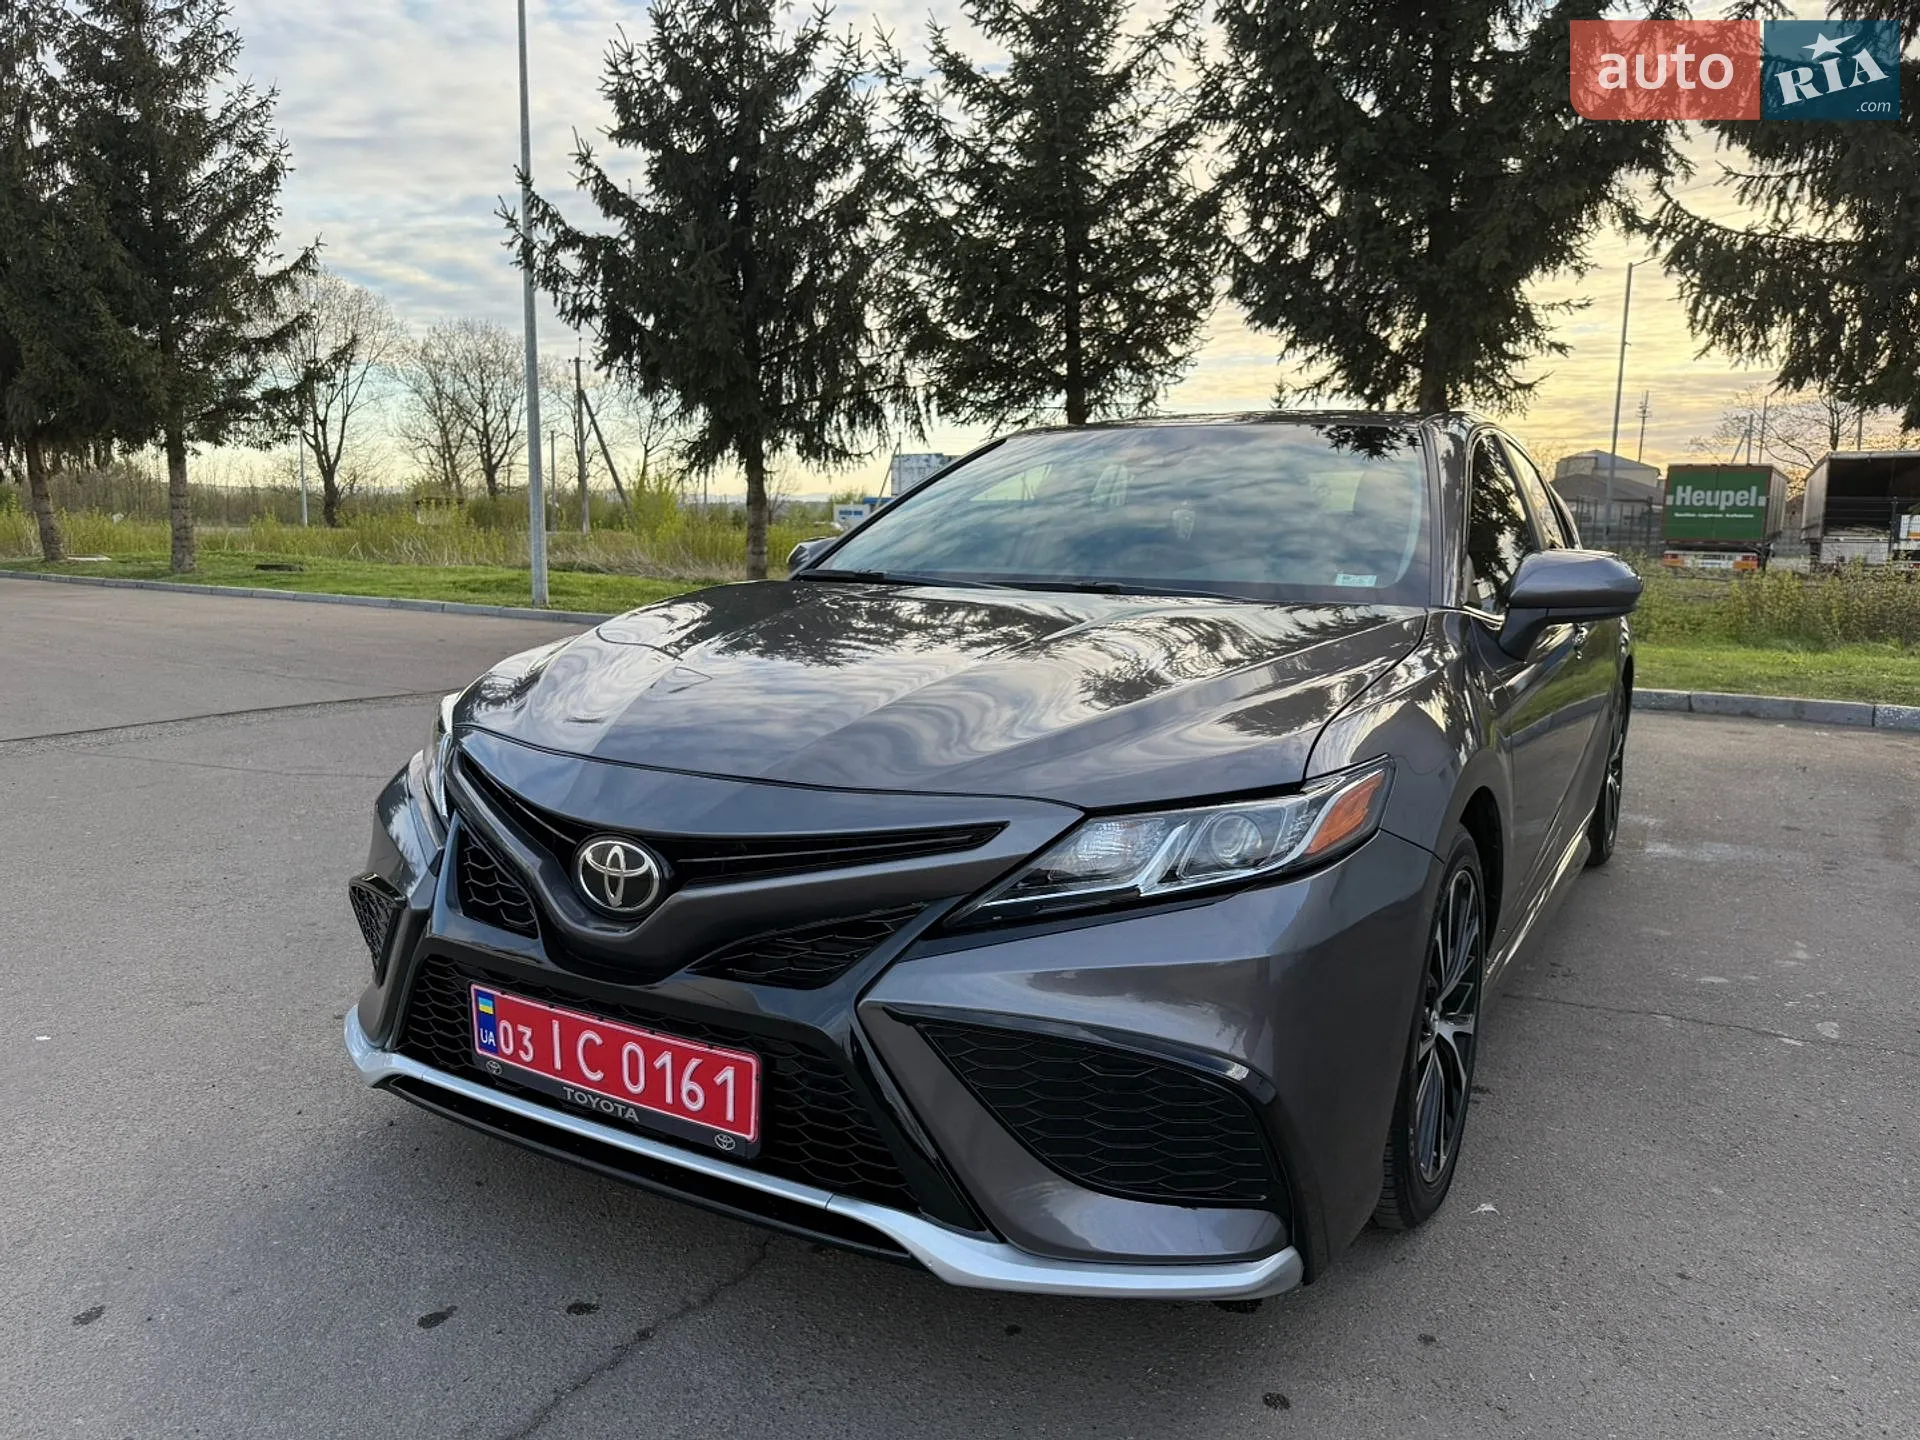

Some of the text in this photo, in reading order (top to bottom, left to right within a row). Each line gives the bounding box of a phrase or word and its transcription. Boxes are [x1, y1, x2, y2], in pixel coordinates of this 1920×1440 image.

[1675, 485, 1758, 510] Heupel
[479, 1027, 496, 1047] UA
[621, 1041, 736, 1123] 0161
[562, 1086, 640, 1123] TOYOTA
